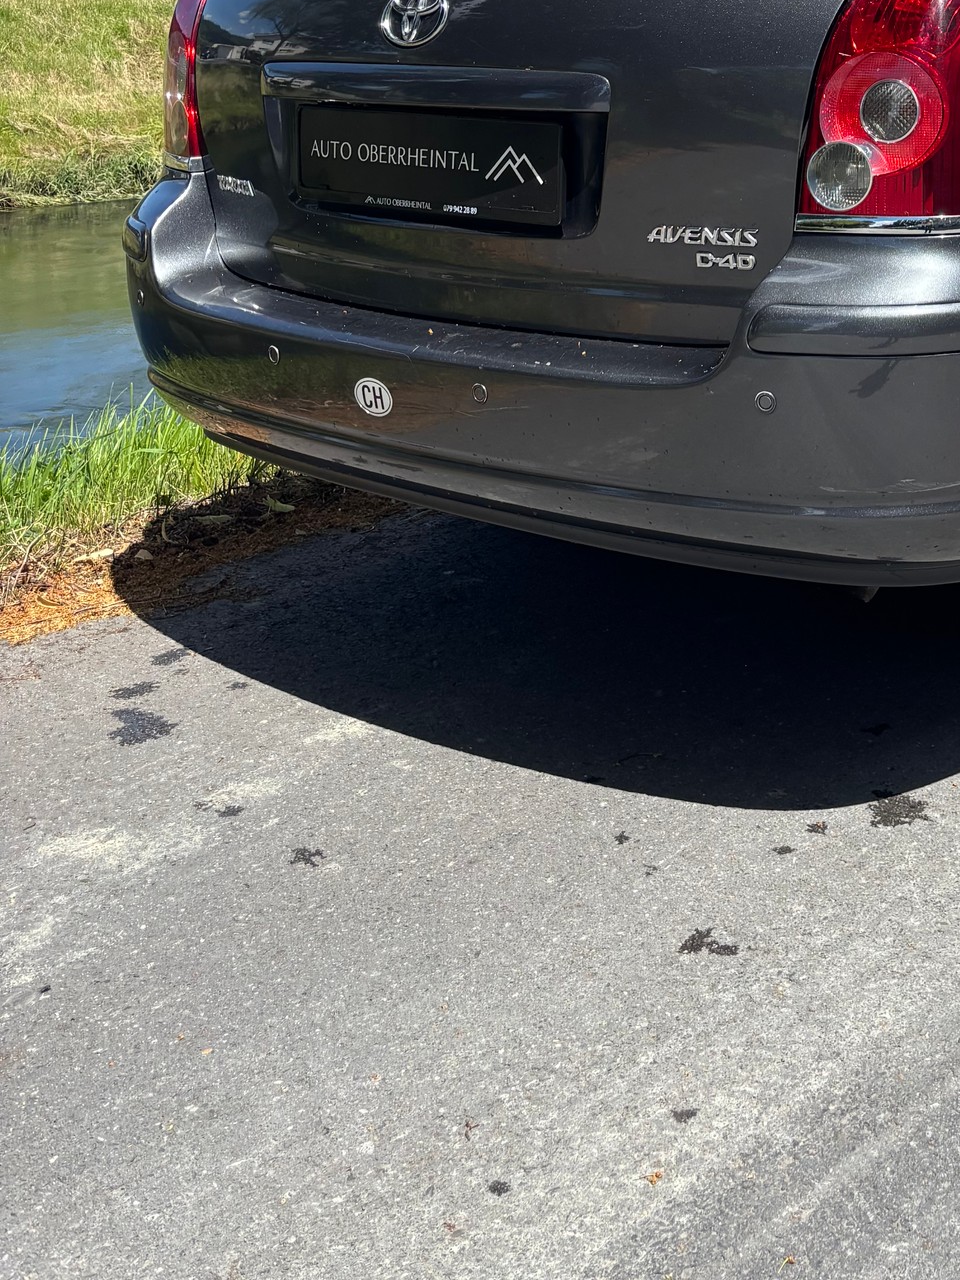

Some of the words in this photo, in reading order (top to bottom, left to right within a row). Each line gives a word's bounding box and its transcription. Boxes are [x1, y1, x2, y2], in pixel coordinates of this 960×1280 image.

[310, 139, 352, 160] AUTO
[357, 142, 480, 172] OBERRHEINTAL
[375, 197, 392, 206] AUTO
[646, 225, 759, 247] AVENSIS
[696, 252, 756, 270] D-4D
[362, 384, 385, 410] CH
